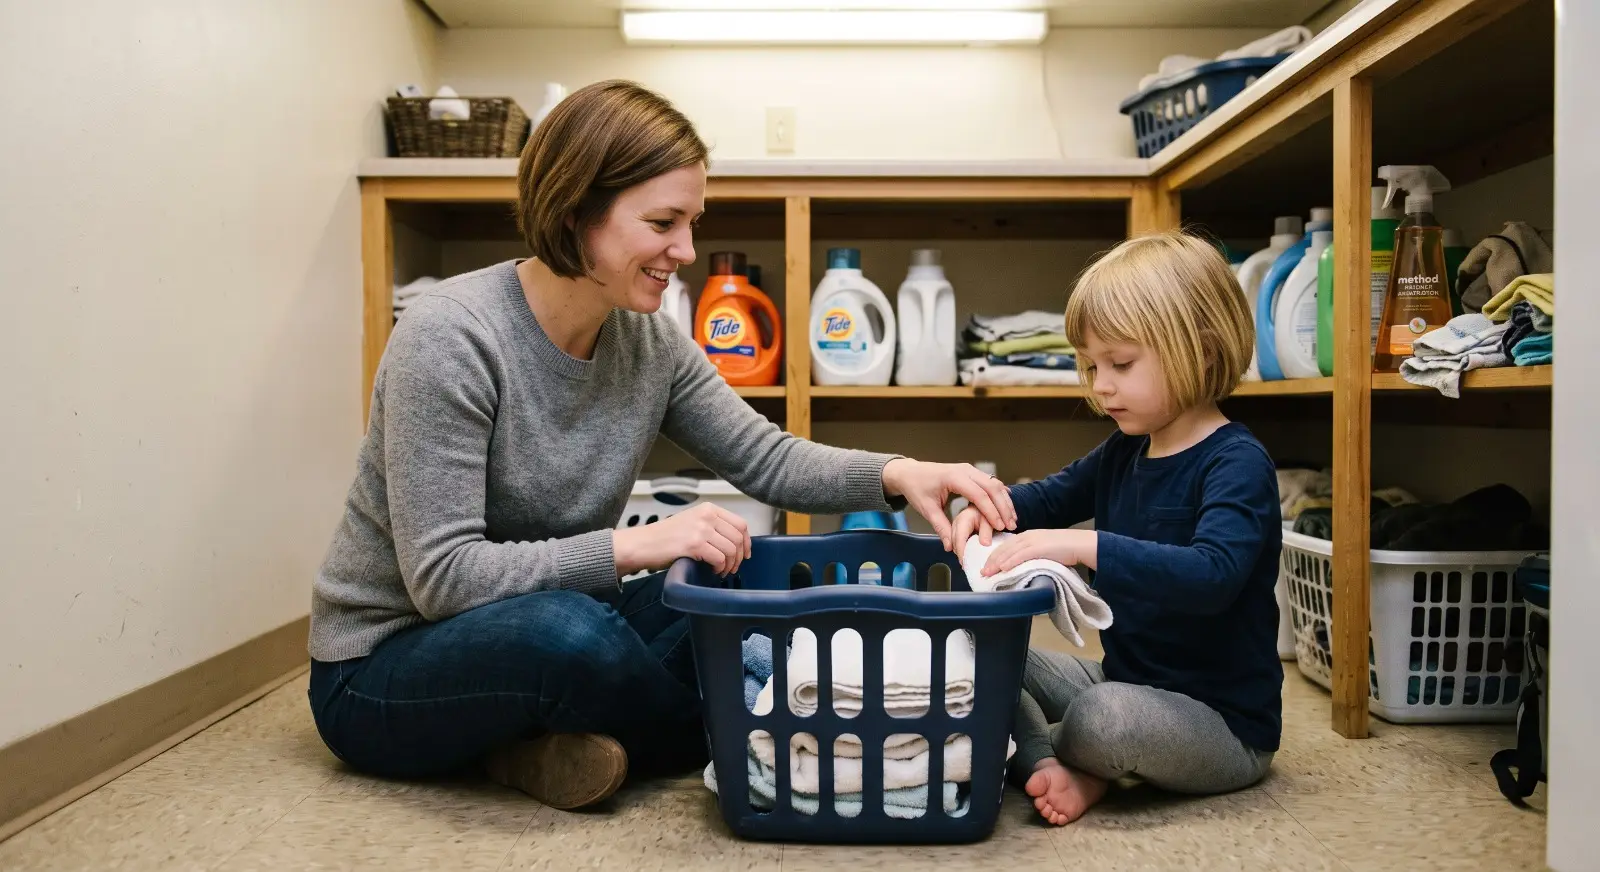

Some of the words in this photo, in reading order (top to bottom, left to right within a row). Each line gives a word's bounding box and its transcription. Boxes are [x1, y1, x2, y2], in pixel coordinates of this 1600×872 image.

[1397, 274, 1439, 285] method
[710, 319, 740, 340] Tide
[825, 316, 851, 334] Tide
